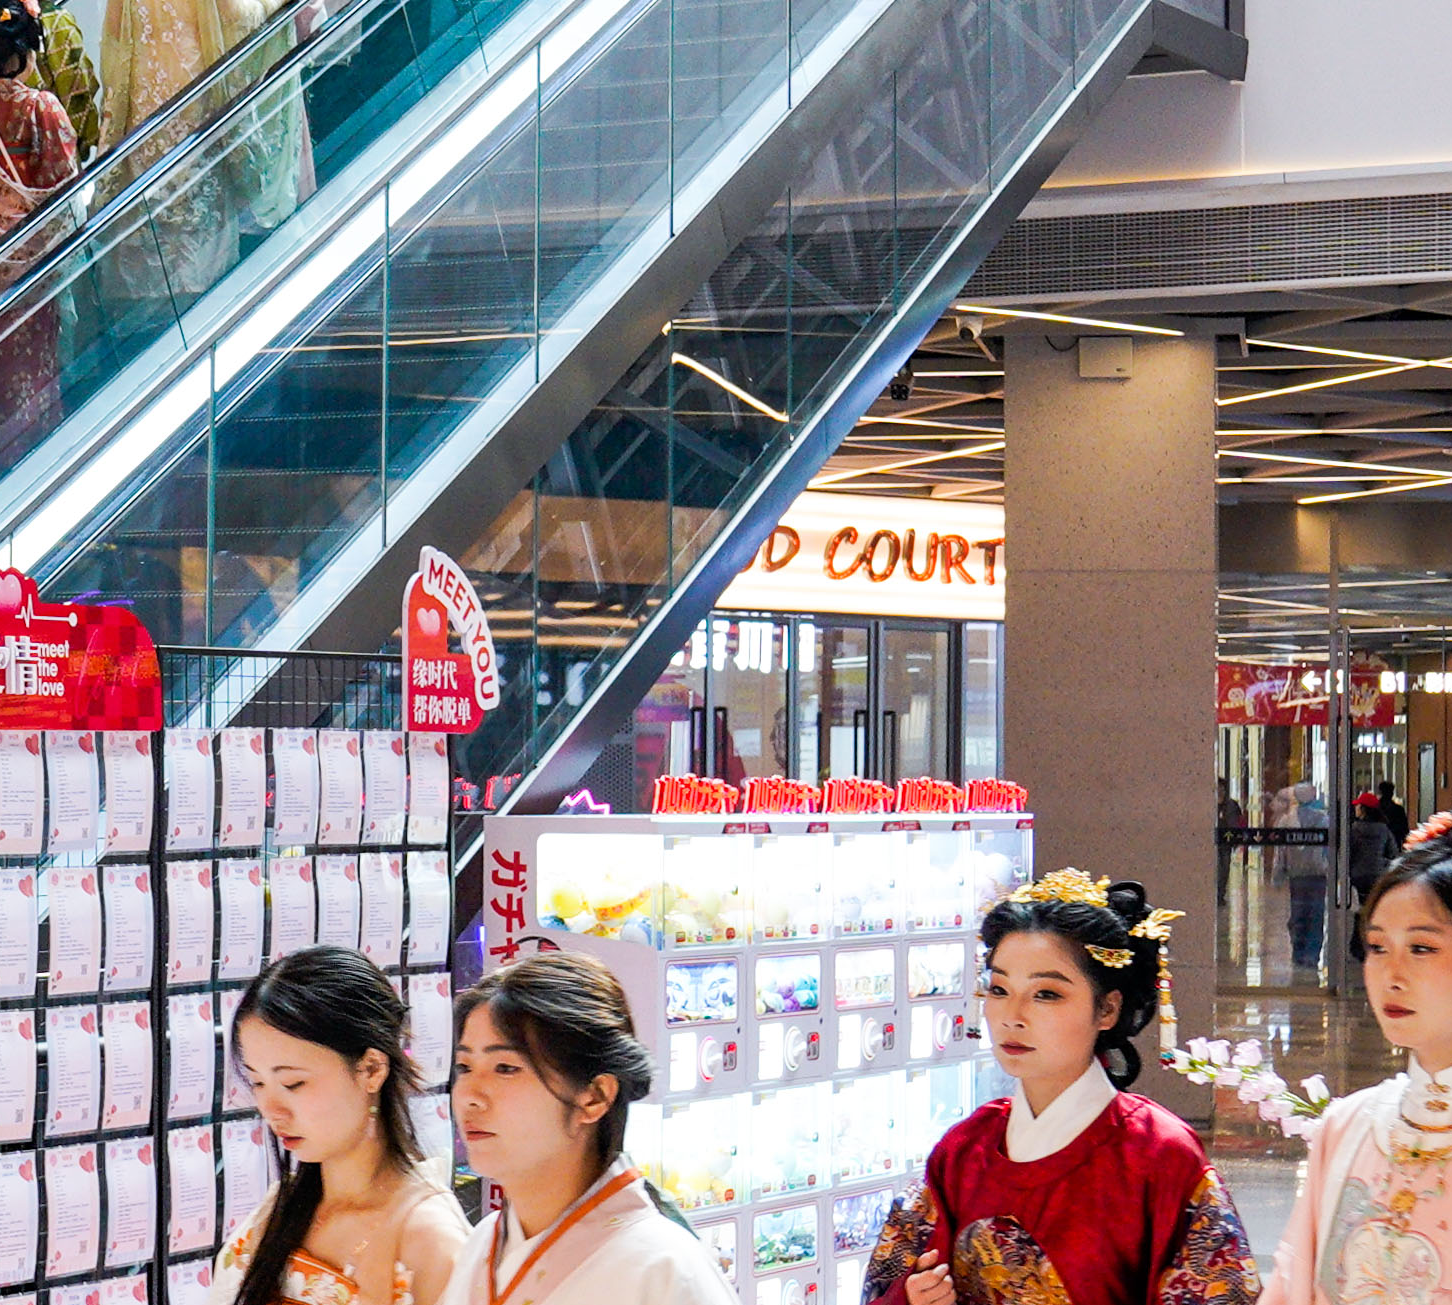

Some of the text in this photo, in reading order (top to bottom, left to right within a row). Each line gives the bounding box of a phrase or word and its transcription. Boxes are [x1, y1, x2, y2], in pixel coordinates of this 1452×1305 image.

[822, 525, 1005, 586] COURT
[428, 557, 494, 700] MEET YOU
[37, 639, 70, 659] meet
[37, 659, 59, 677] the
[412, 658, 458, 691] 缘时代
[37, 678, 65, 697] love
[412, 693, 472, 726] 帮你脱单
